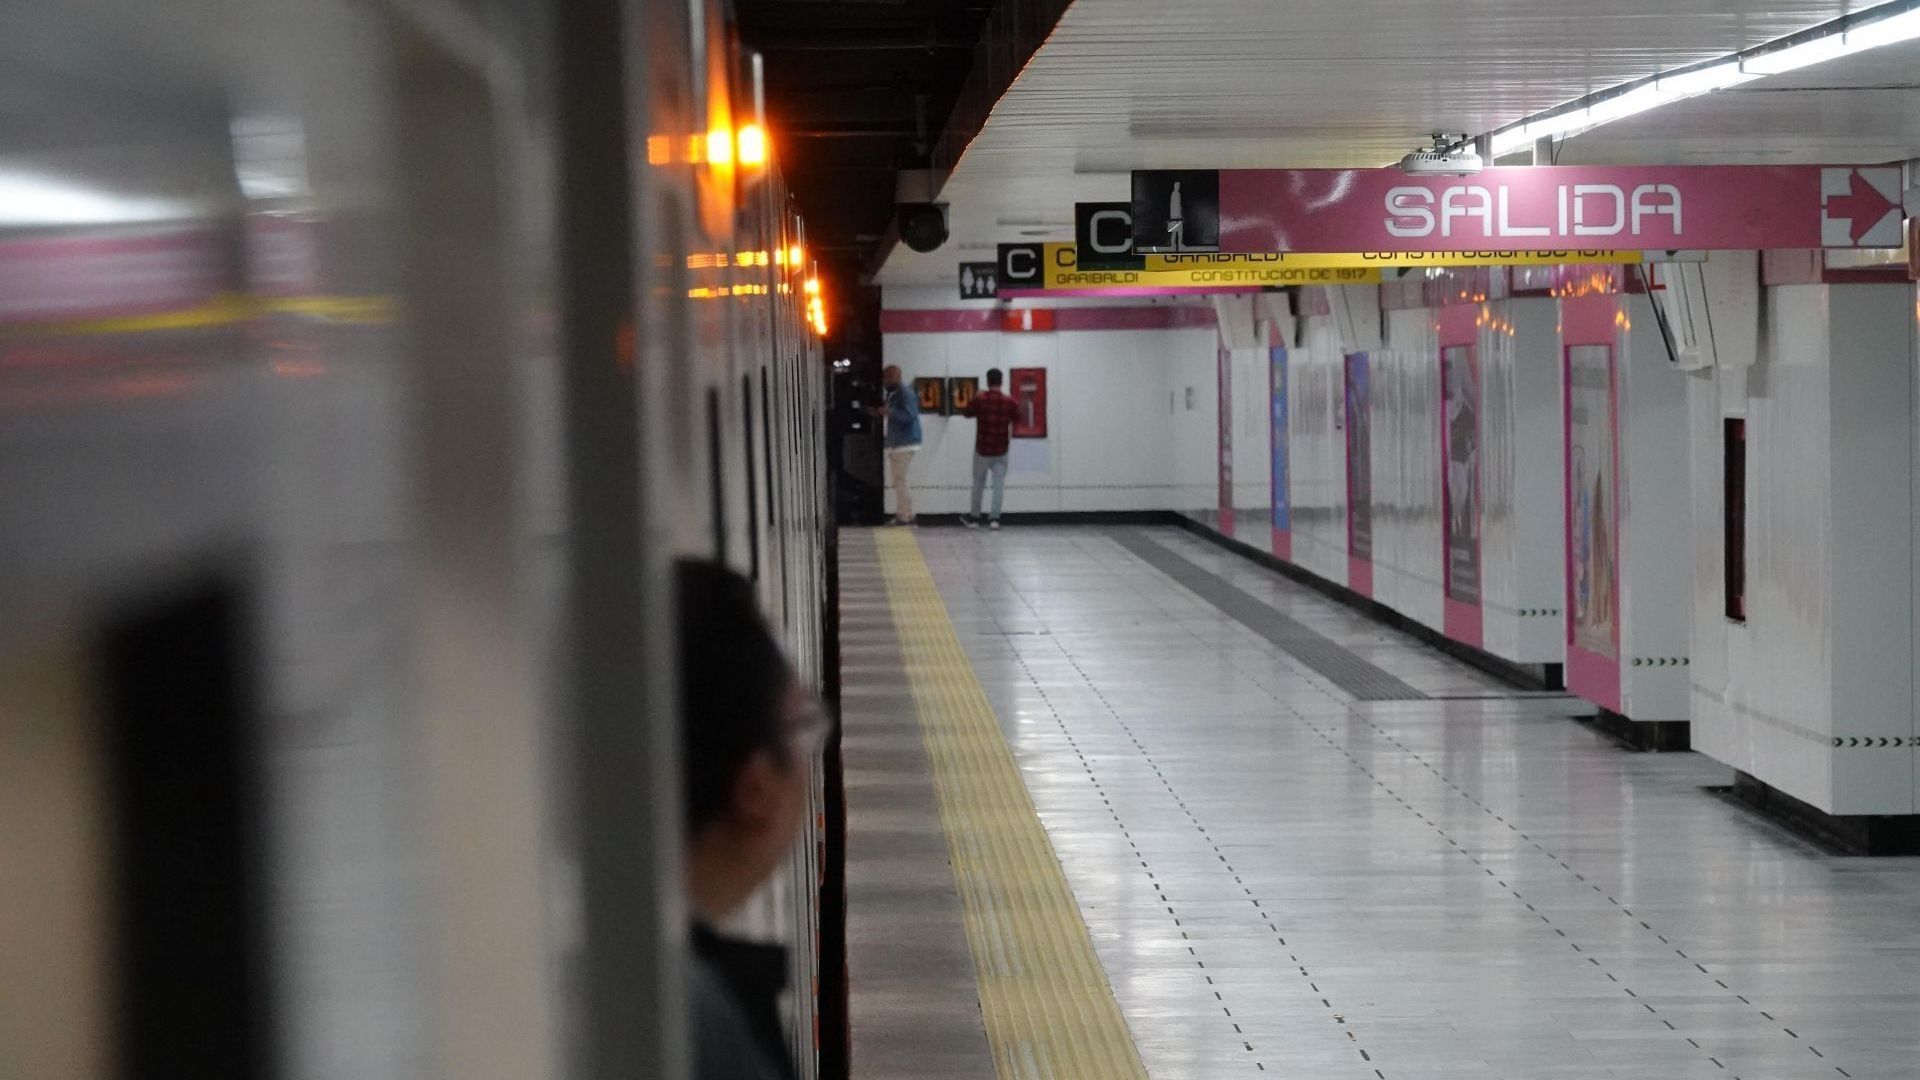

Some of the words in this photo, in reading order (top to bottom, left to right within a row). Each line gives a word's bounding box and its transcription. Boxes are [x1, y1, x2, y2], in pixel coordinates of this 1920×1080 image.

[1384, 183, 1683, 237] SALIDA
[1090, 210, 1132, 253] C
[1007, 249, 1036, 278] C
[1309, 269, 1330, 280] DE
[1336, 268, 1367, 280] 1917
[1056, 272, 1139, 285] GARIBALDI
